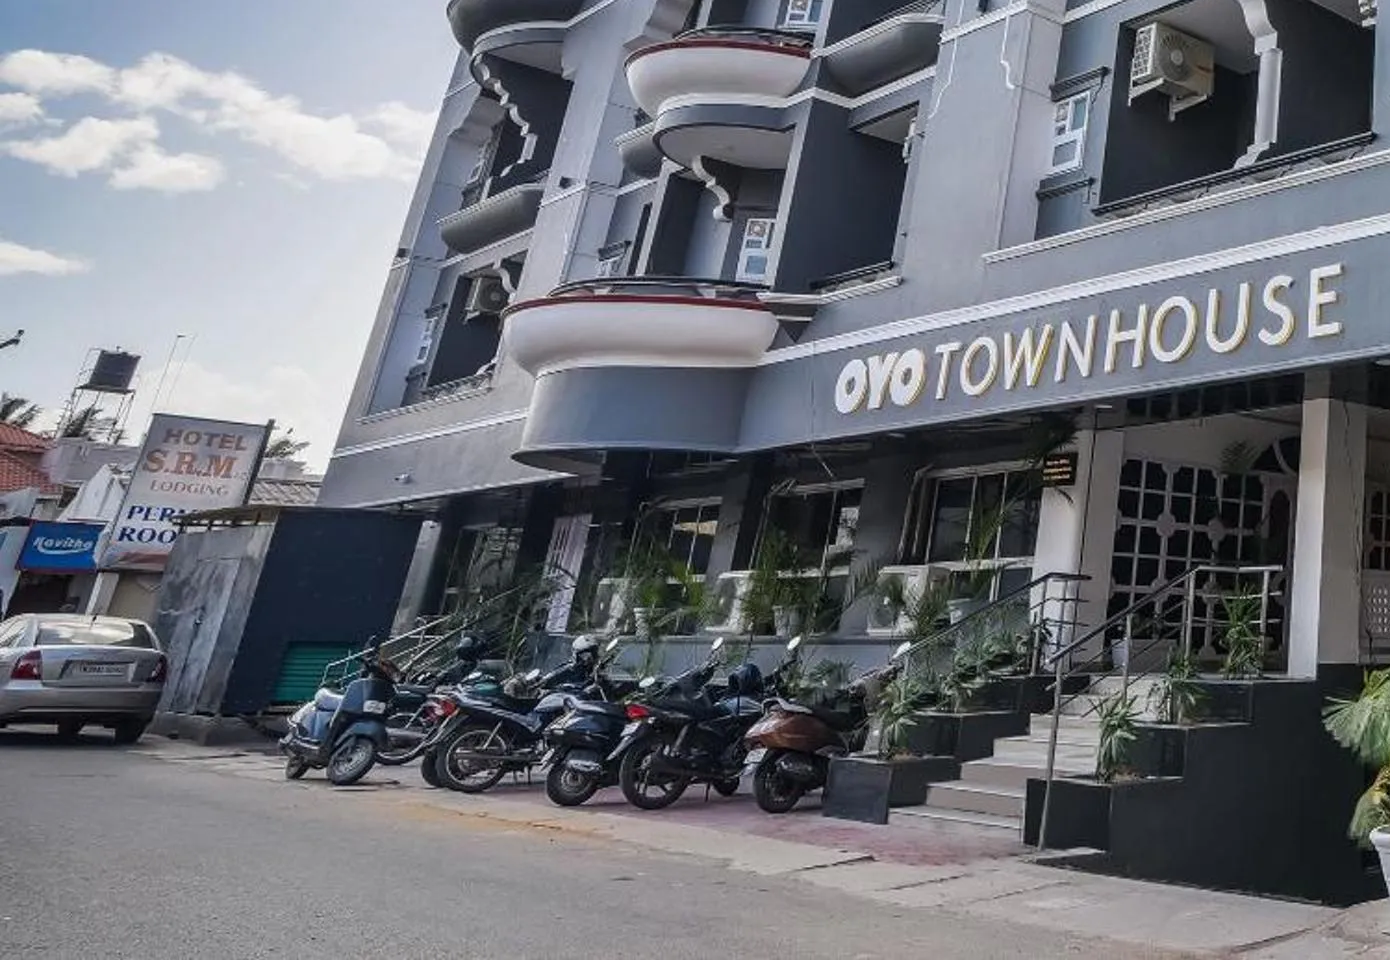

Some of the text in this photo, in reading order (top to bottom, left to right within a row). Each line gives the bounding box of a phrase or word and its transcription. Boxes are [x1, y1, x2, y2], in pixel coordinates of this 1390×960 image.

[835, 348, 926, 413] OYO
[163, 428, 247, 451] HOTEL
[151, 480, 229, 496] LODGING
[127, 505, 192, 522] PER
[118, 526, 177, 544] ROO
